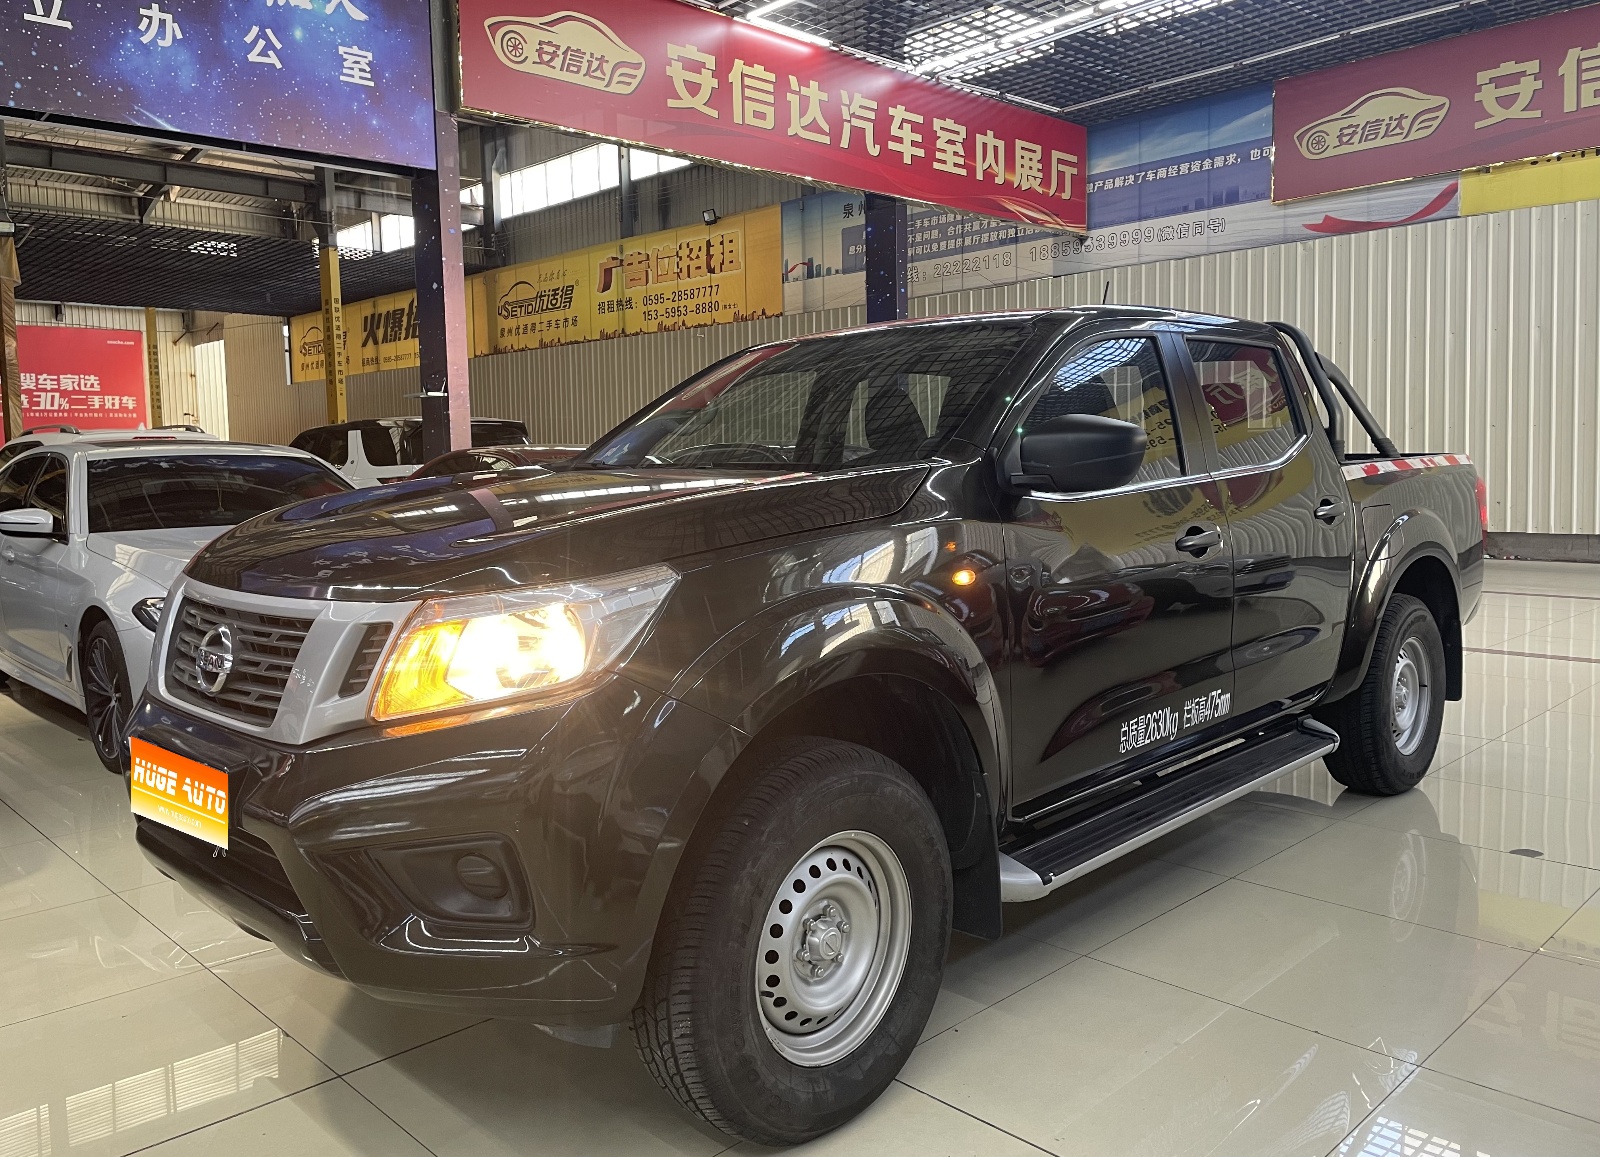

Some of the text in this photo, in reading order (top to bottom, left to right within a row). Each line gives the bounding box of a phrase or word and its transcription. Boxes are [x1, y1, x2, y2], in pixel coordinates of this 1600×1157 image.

[532, 39, 608, 83] 安信达
[665, 43, 1080, 201] 安信达汽车室内展厅
[1333, 113, 1409, 149] 安信达
[596, 231, 742, 294] 广告位招租
[642, 300, 719, 322] 153-5953-8880
